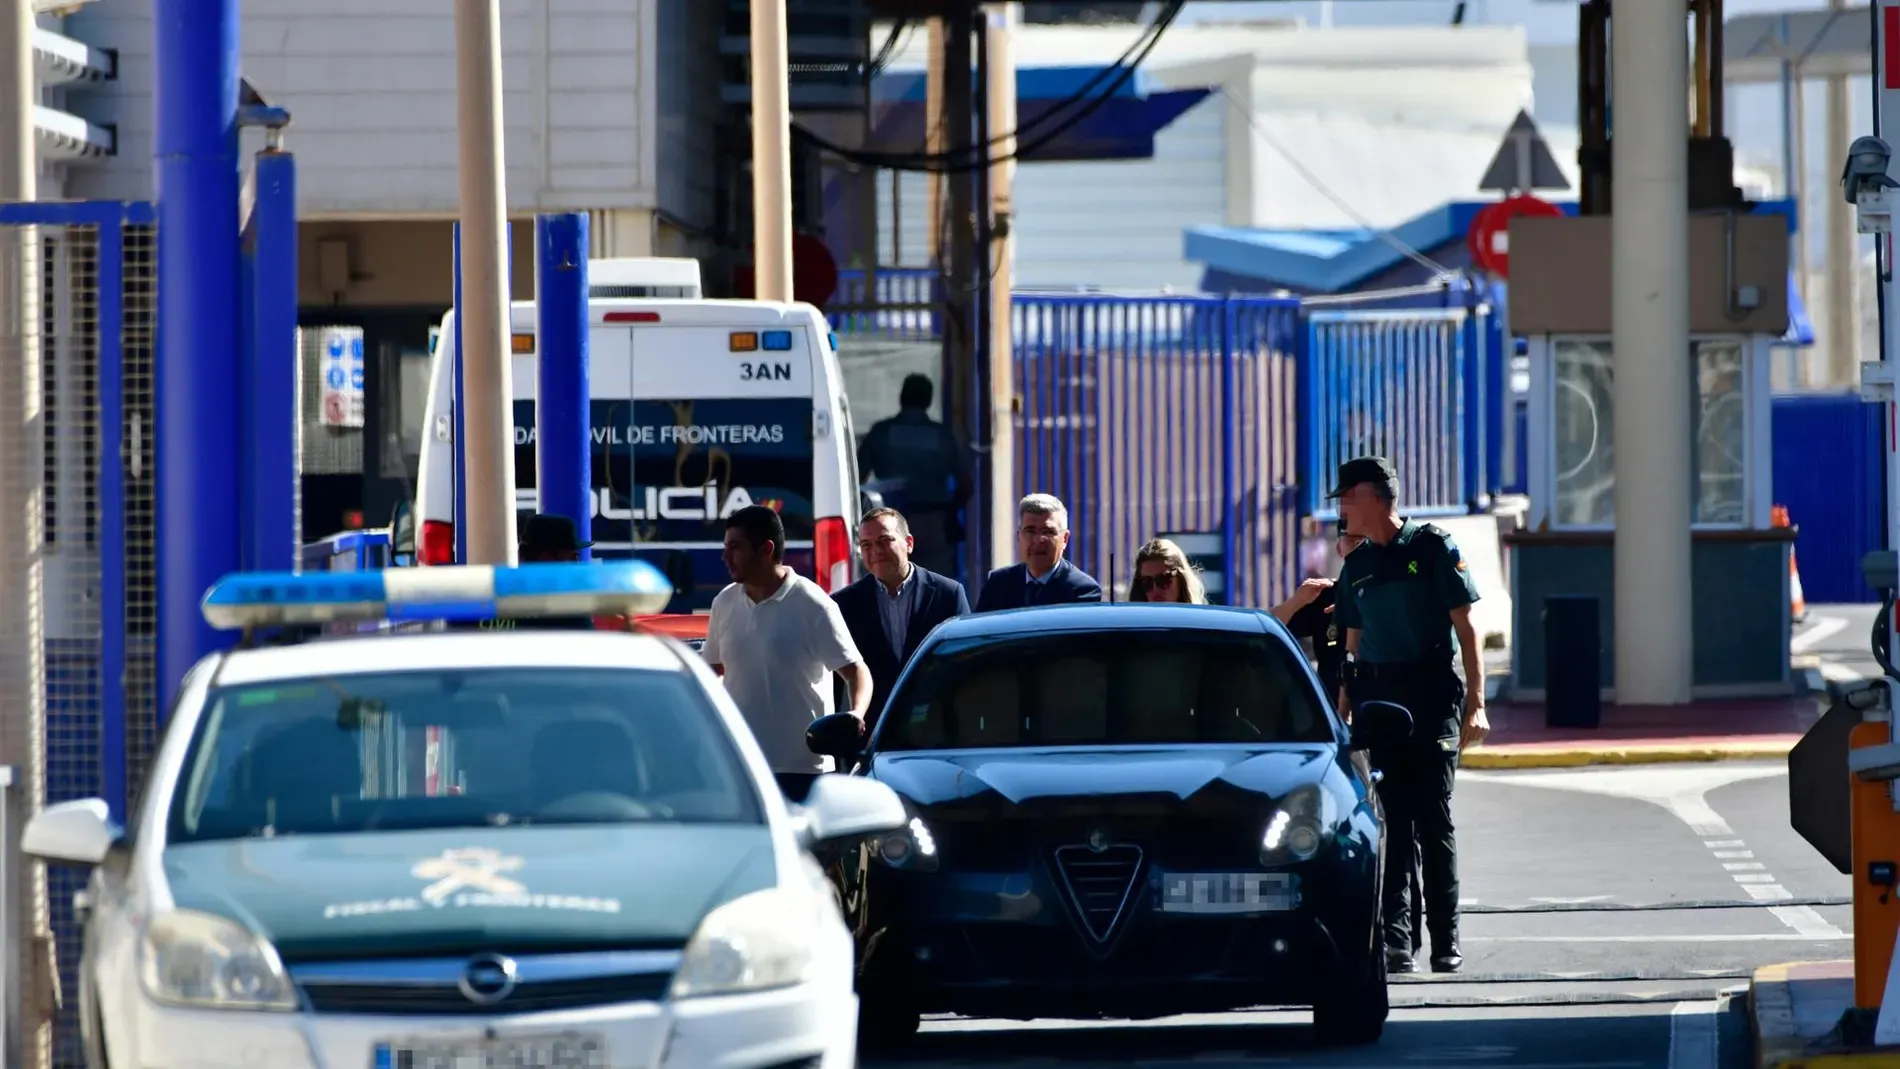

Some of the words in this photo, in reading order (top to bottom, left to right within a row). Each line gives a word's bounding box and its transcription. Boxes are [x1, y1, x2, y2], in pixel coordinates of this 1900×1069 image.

[740, 363, 791, 380] 3AN
[627, 425, 655, 444] DE
[660, 425, 784, 444] FRONTERAS
